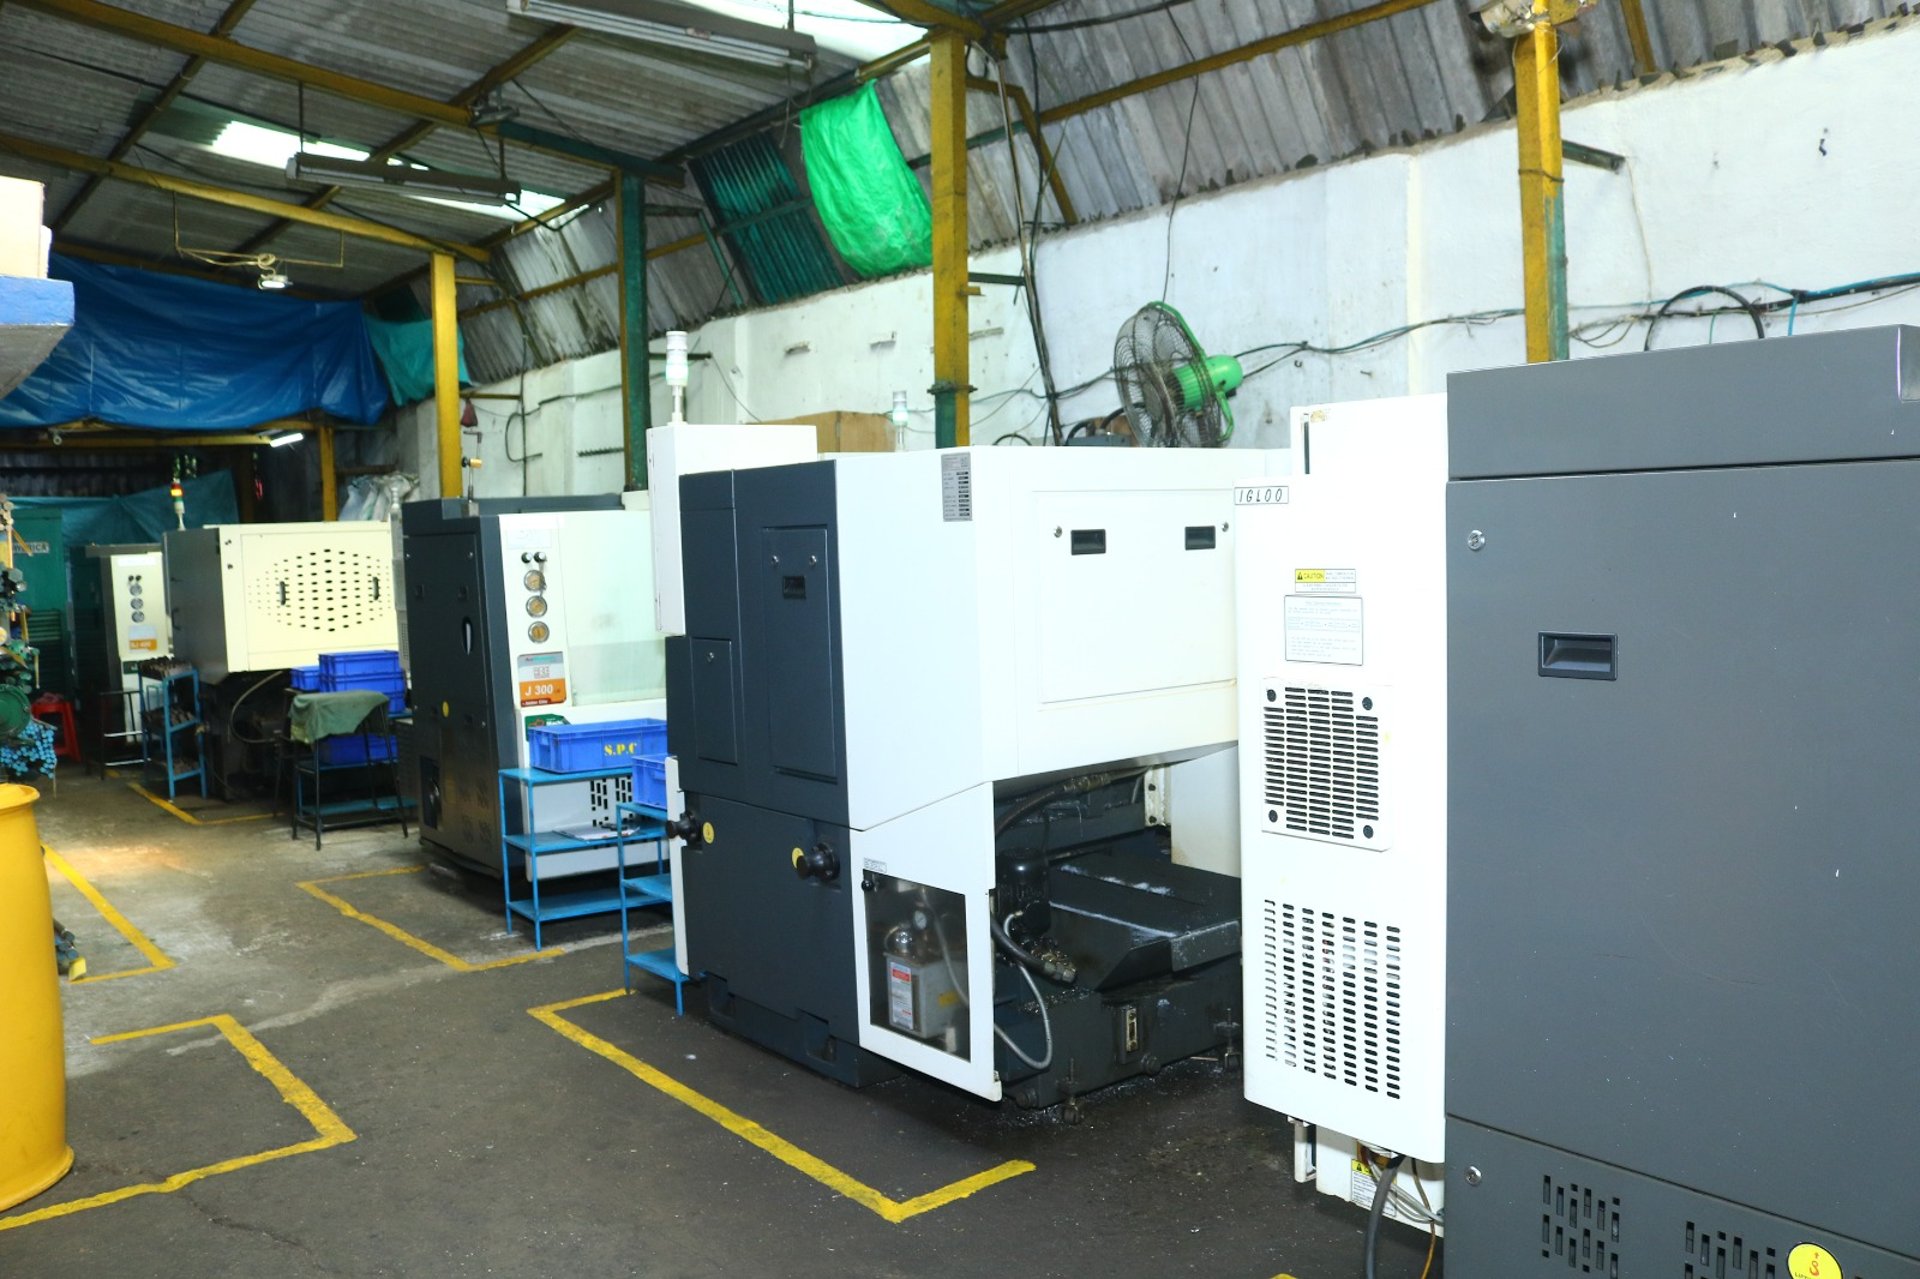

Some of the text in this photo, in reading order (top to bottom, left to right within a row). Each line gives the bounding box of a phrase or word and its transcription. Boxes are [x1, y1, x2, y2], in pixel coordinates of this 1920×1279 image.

[1239, 487, 1283, 502] IGLOO
[525, 684, 553, 697] J 300
